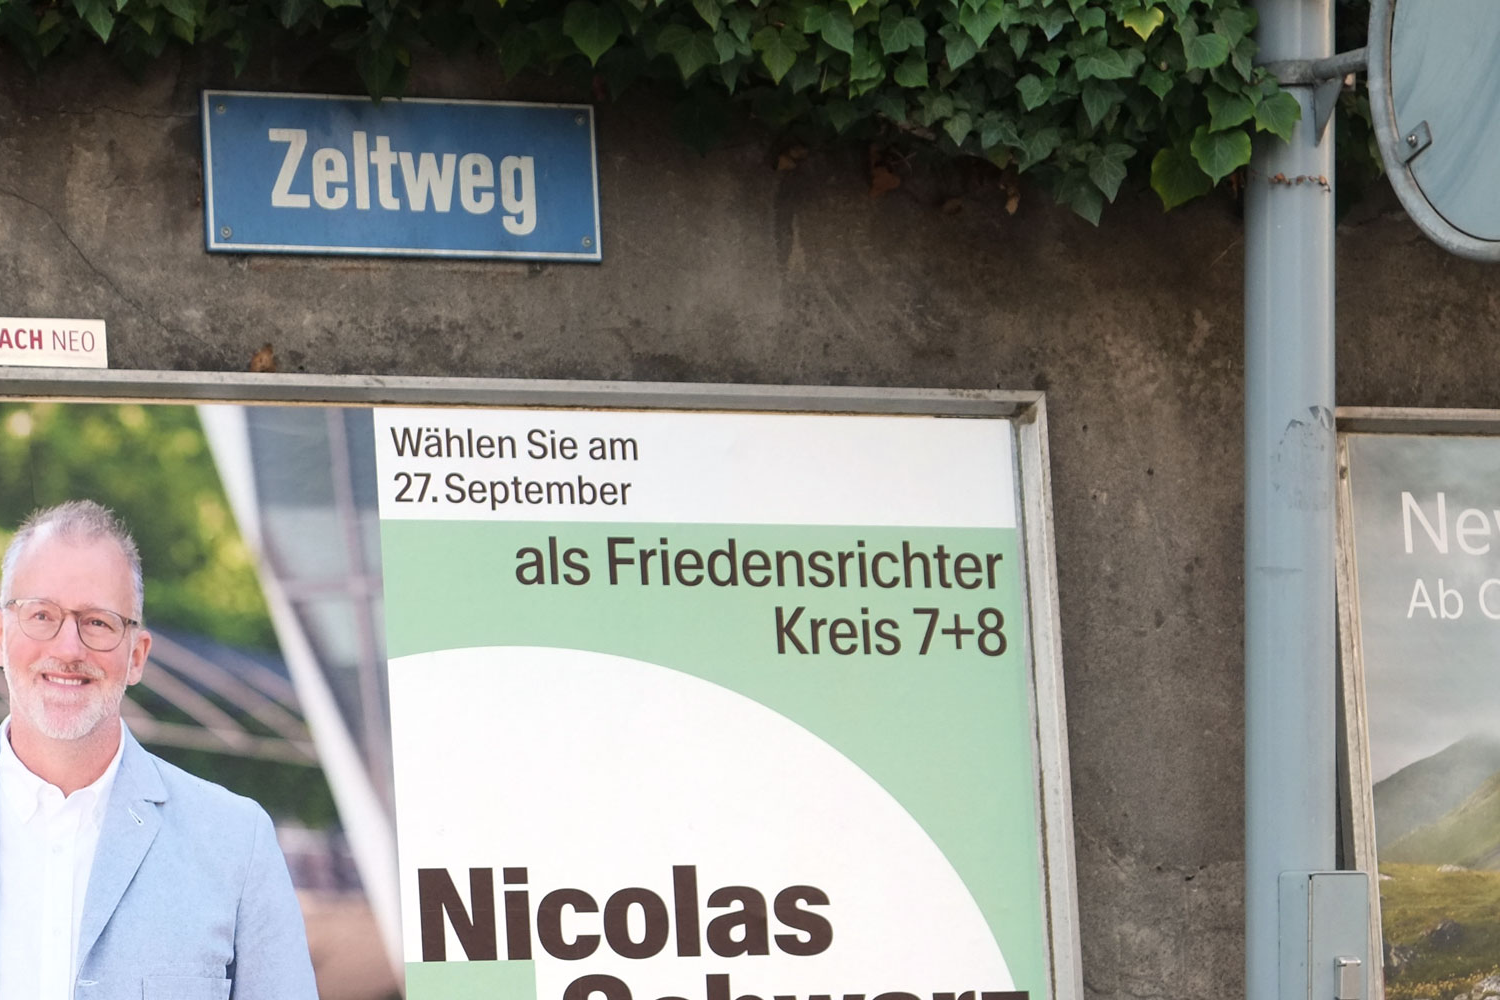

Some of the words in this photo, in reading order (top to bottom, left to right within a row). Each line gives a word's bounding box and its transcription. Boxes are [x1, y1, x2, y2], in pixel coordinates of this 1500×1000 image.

[268, 127, 537, 237] Zeltweg
[51, 330, 96, 354] NEO
[390, 426, 517, 459] Wählen
[527, 429, 578, 460] Sie
[588, 436, 639, 461] am
[514, 537, 592, 586] als
[607, 536, 1003, 590] Friedensrichter
[1407, 578, 1464, 620] Ab
[775, 606, 902, 656] Kreis
[912, 607, 1009, 657] 7+8
[417, 864, 834, 963] Nicolas
